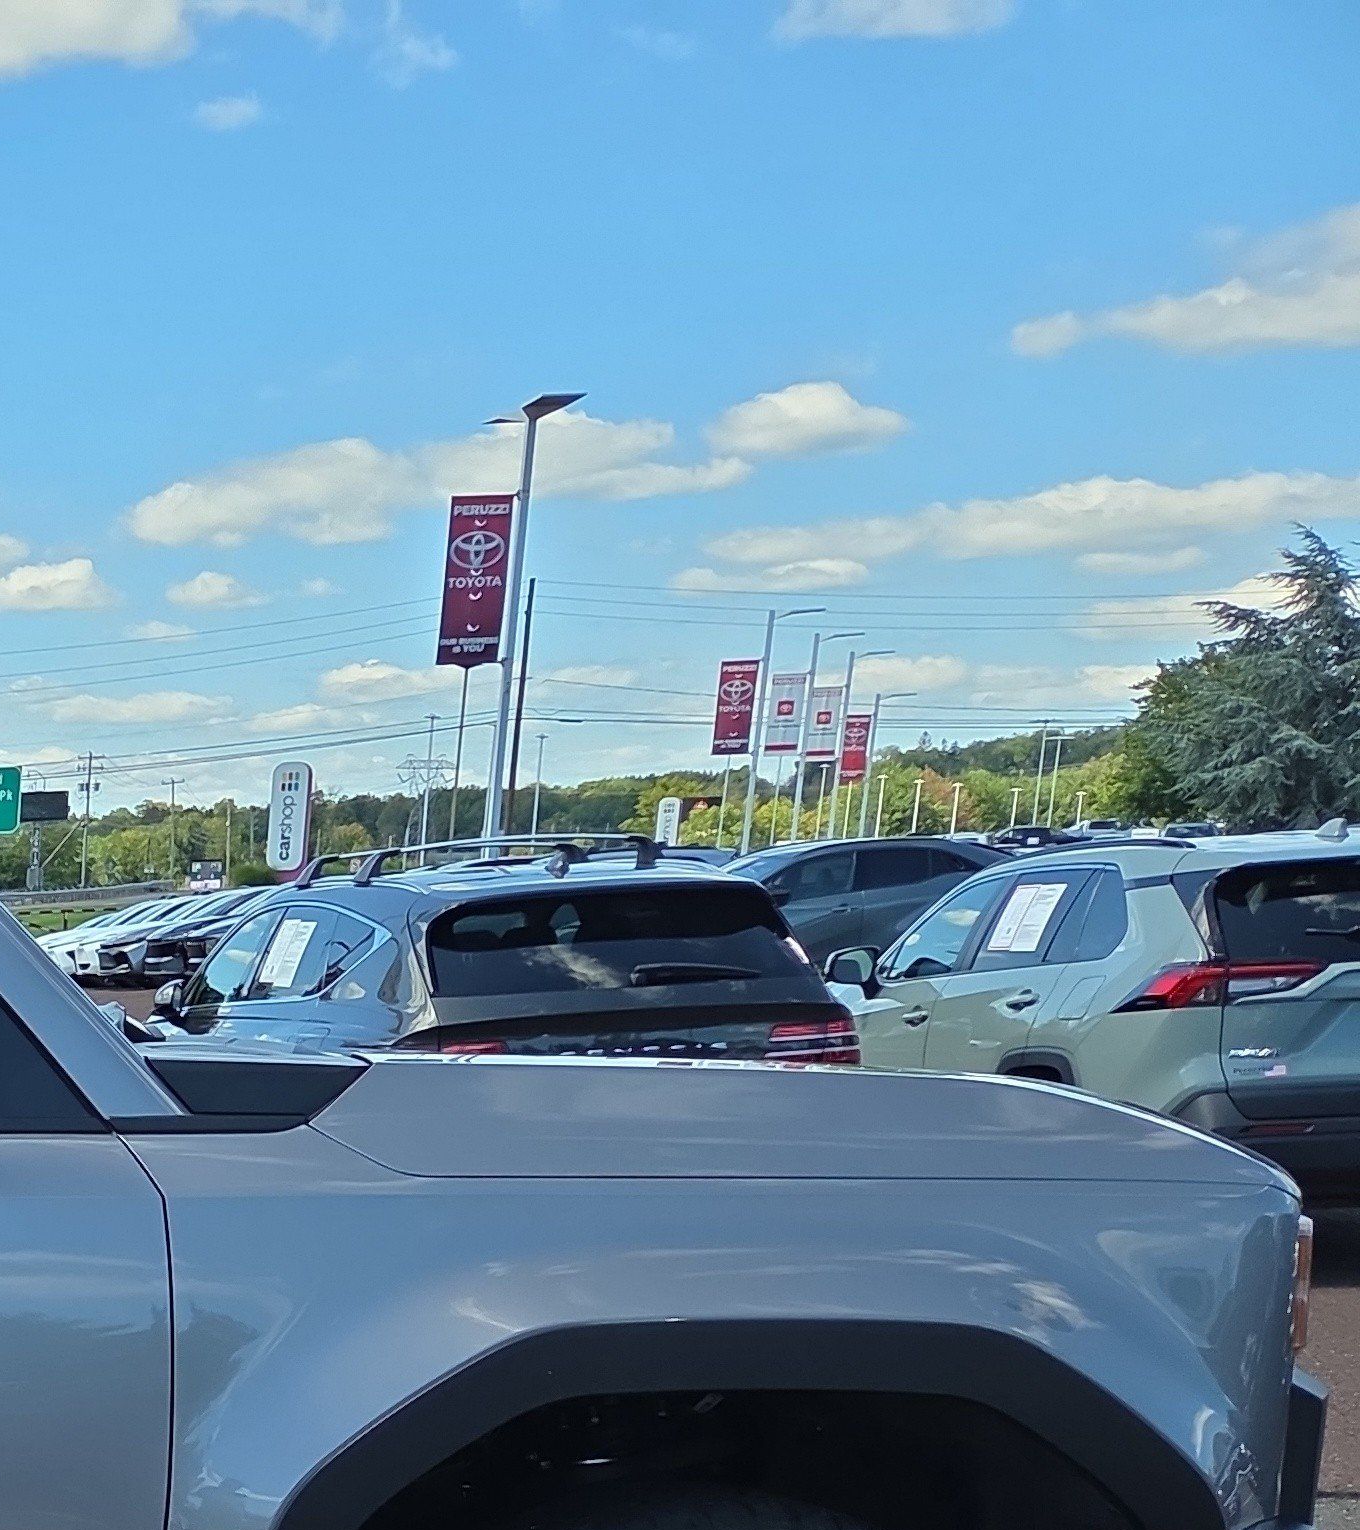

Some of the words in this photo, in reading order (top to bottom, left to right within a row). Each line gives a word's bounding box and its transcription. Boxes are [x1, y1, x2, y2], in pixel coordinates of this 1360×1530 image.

[453, 504, 510, 516] PERUZZI
[448, 575, 502, 589] TOYOTA
[0, 789, 13, 801] Pk
[279, 795, 297, 861] carshop
